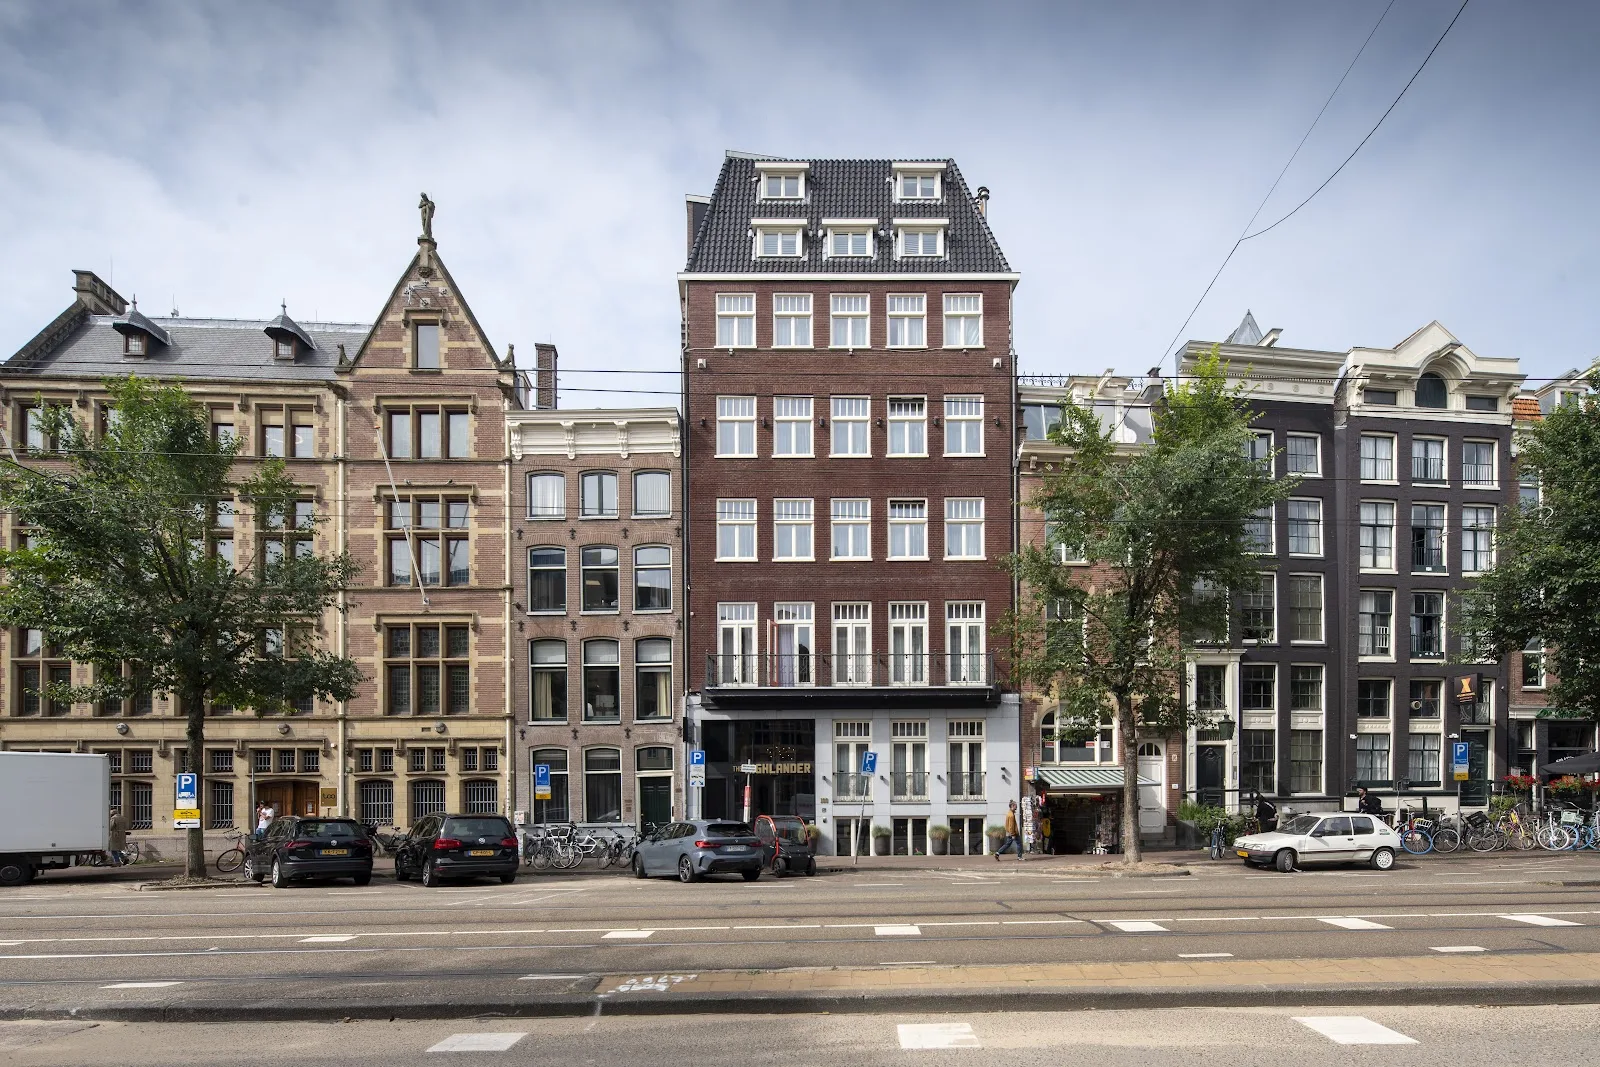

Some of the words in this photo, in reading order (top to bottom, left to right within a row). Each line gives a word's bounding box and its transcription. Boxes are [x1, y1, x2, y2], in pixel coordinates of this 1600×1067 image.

[1457, 745, 1465, 756] P
[693, 752, 702, 763] P
[866, 753, 875, 764] P
[538, 766, 547, 777] P
[756, 763, 811, 774] GHLANDER
[181, 775, 192, 789] P
